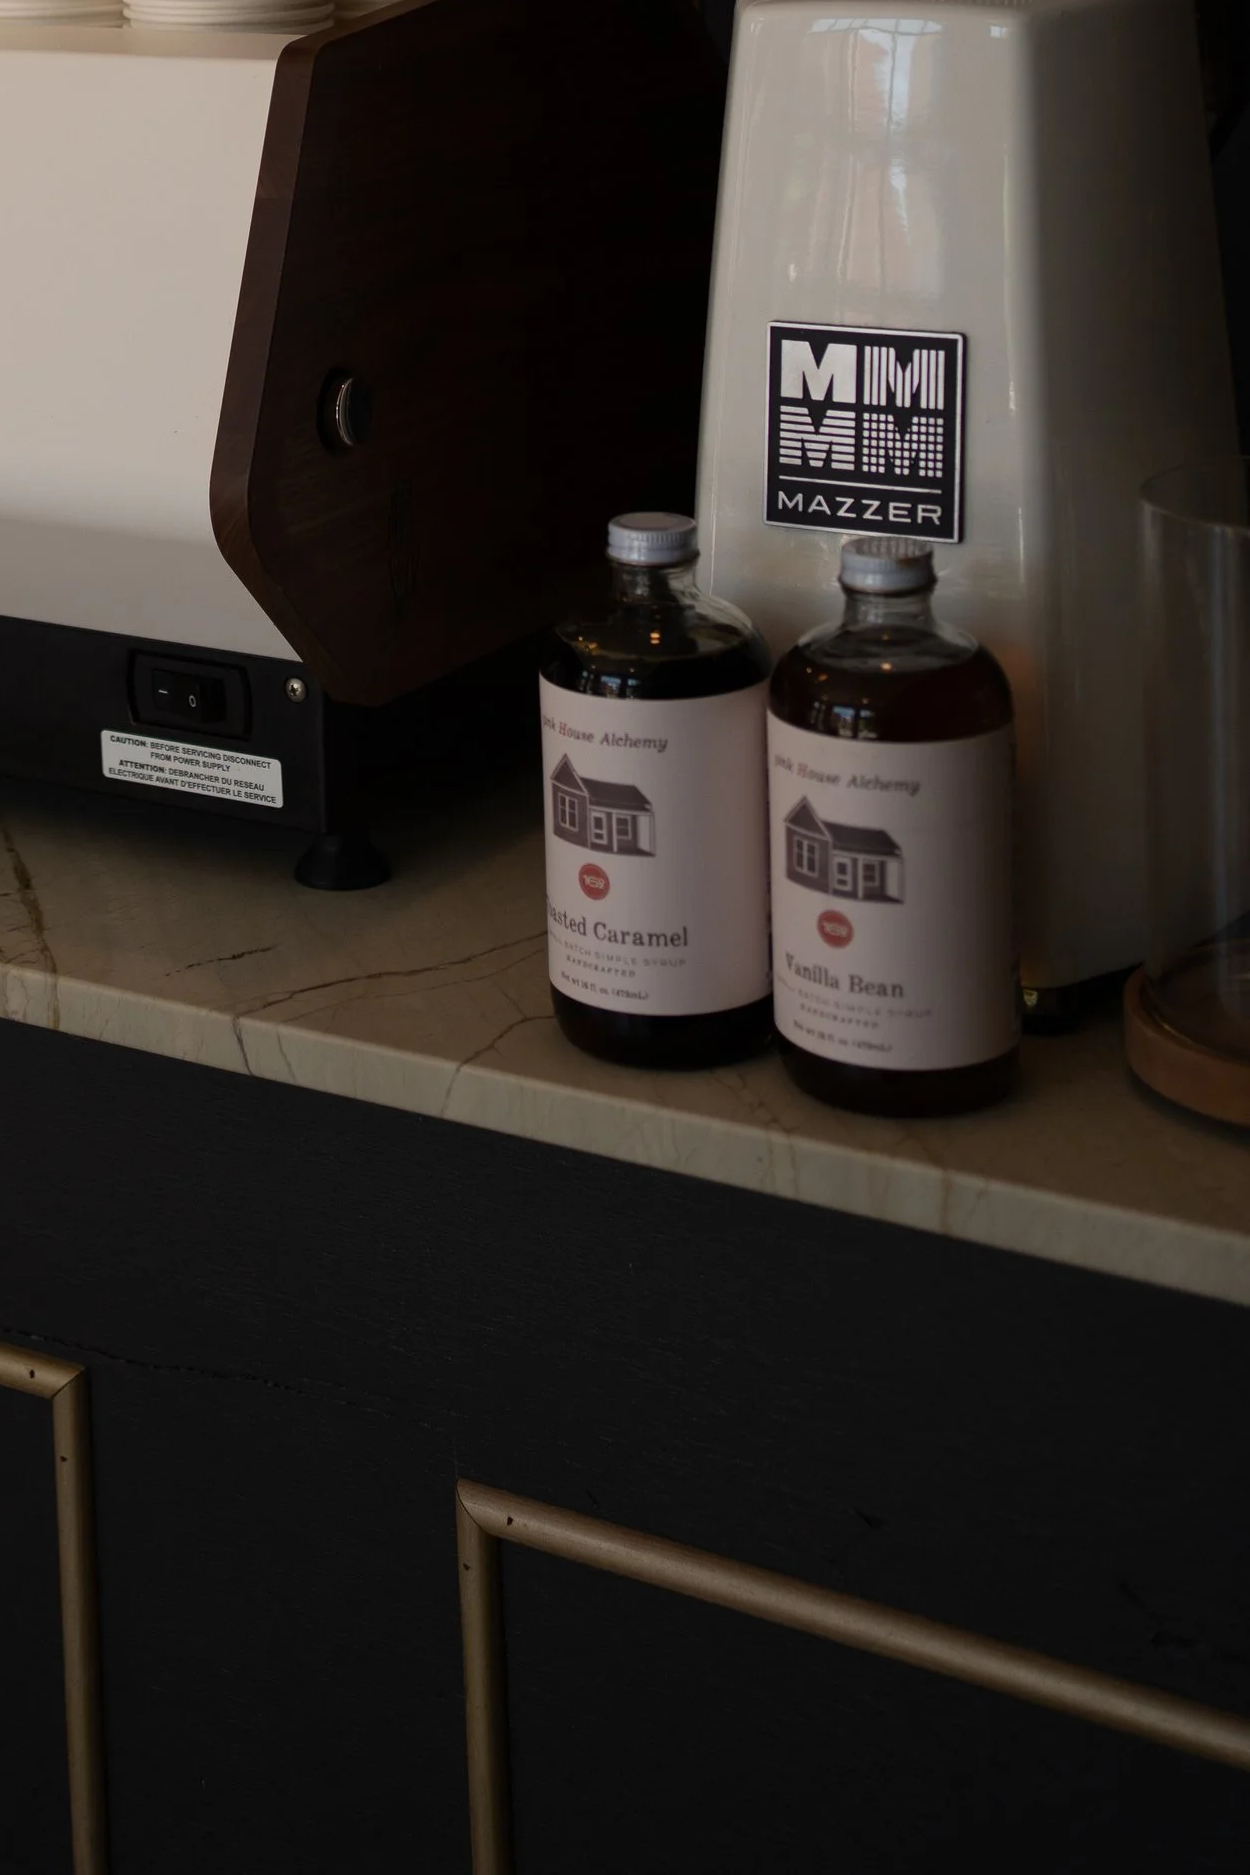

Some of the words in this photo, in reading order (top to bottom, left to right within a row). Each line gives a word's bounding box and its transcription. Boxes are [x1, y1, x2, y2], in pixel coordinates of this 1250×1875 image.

[777, 489, 943, 525] MAZZER
[109, 735, 149, 748] CAUTION:
[150, 742, 181, 754] BEFORE
[181, 747, 222, 761] SERVICING
[222, 754, 272, 770] DISCONNECT
[558, 721, 595, 744] House
[600, 731, 669, 753] Alchemy
[118, 759, 167, 774] ATTENTION:
[168, 768, 220, 783] DEBRANCHER
[221, 776, 232, 785] DU
[233, 779, 265, 792] RESEAU
[150, 751, 172, 762] FROM
[173, 755, 201, 767] POWER
[201, 761, 231, 773] SUPPLY
[155, 775, 179, 787] AVANT
[232, 788, 243, 798] LE
[243, 791, 277, 804] SERVICE
[846, 774, 922, 797] Alchemy
[593, 921, 689, 948] Caramel
[784, 952, 840, 991] Vanilla
[848, 973, 905, 999] Bean
